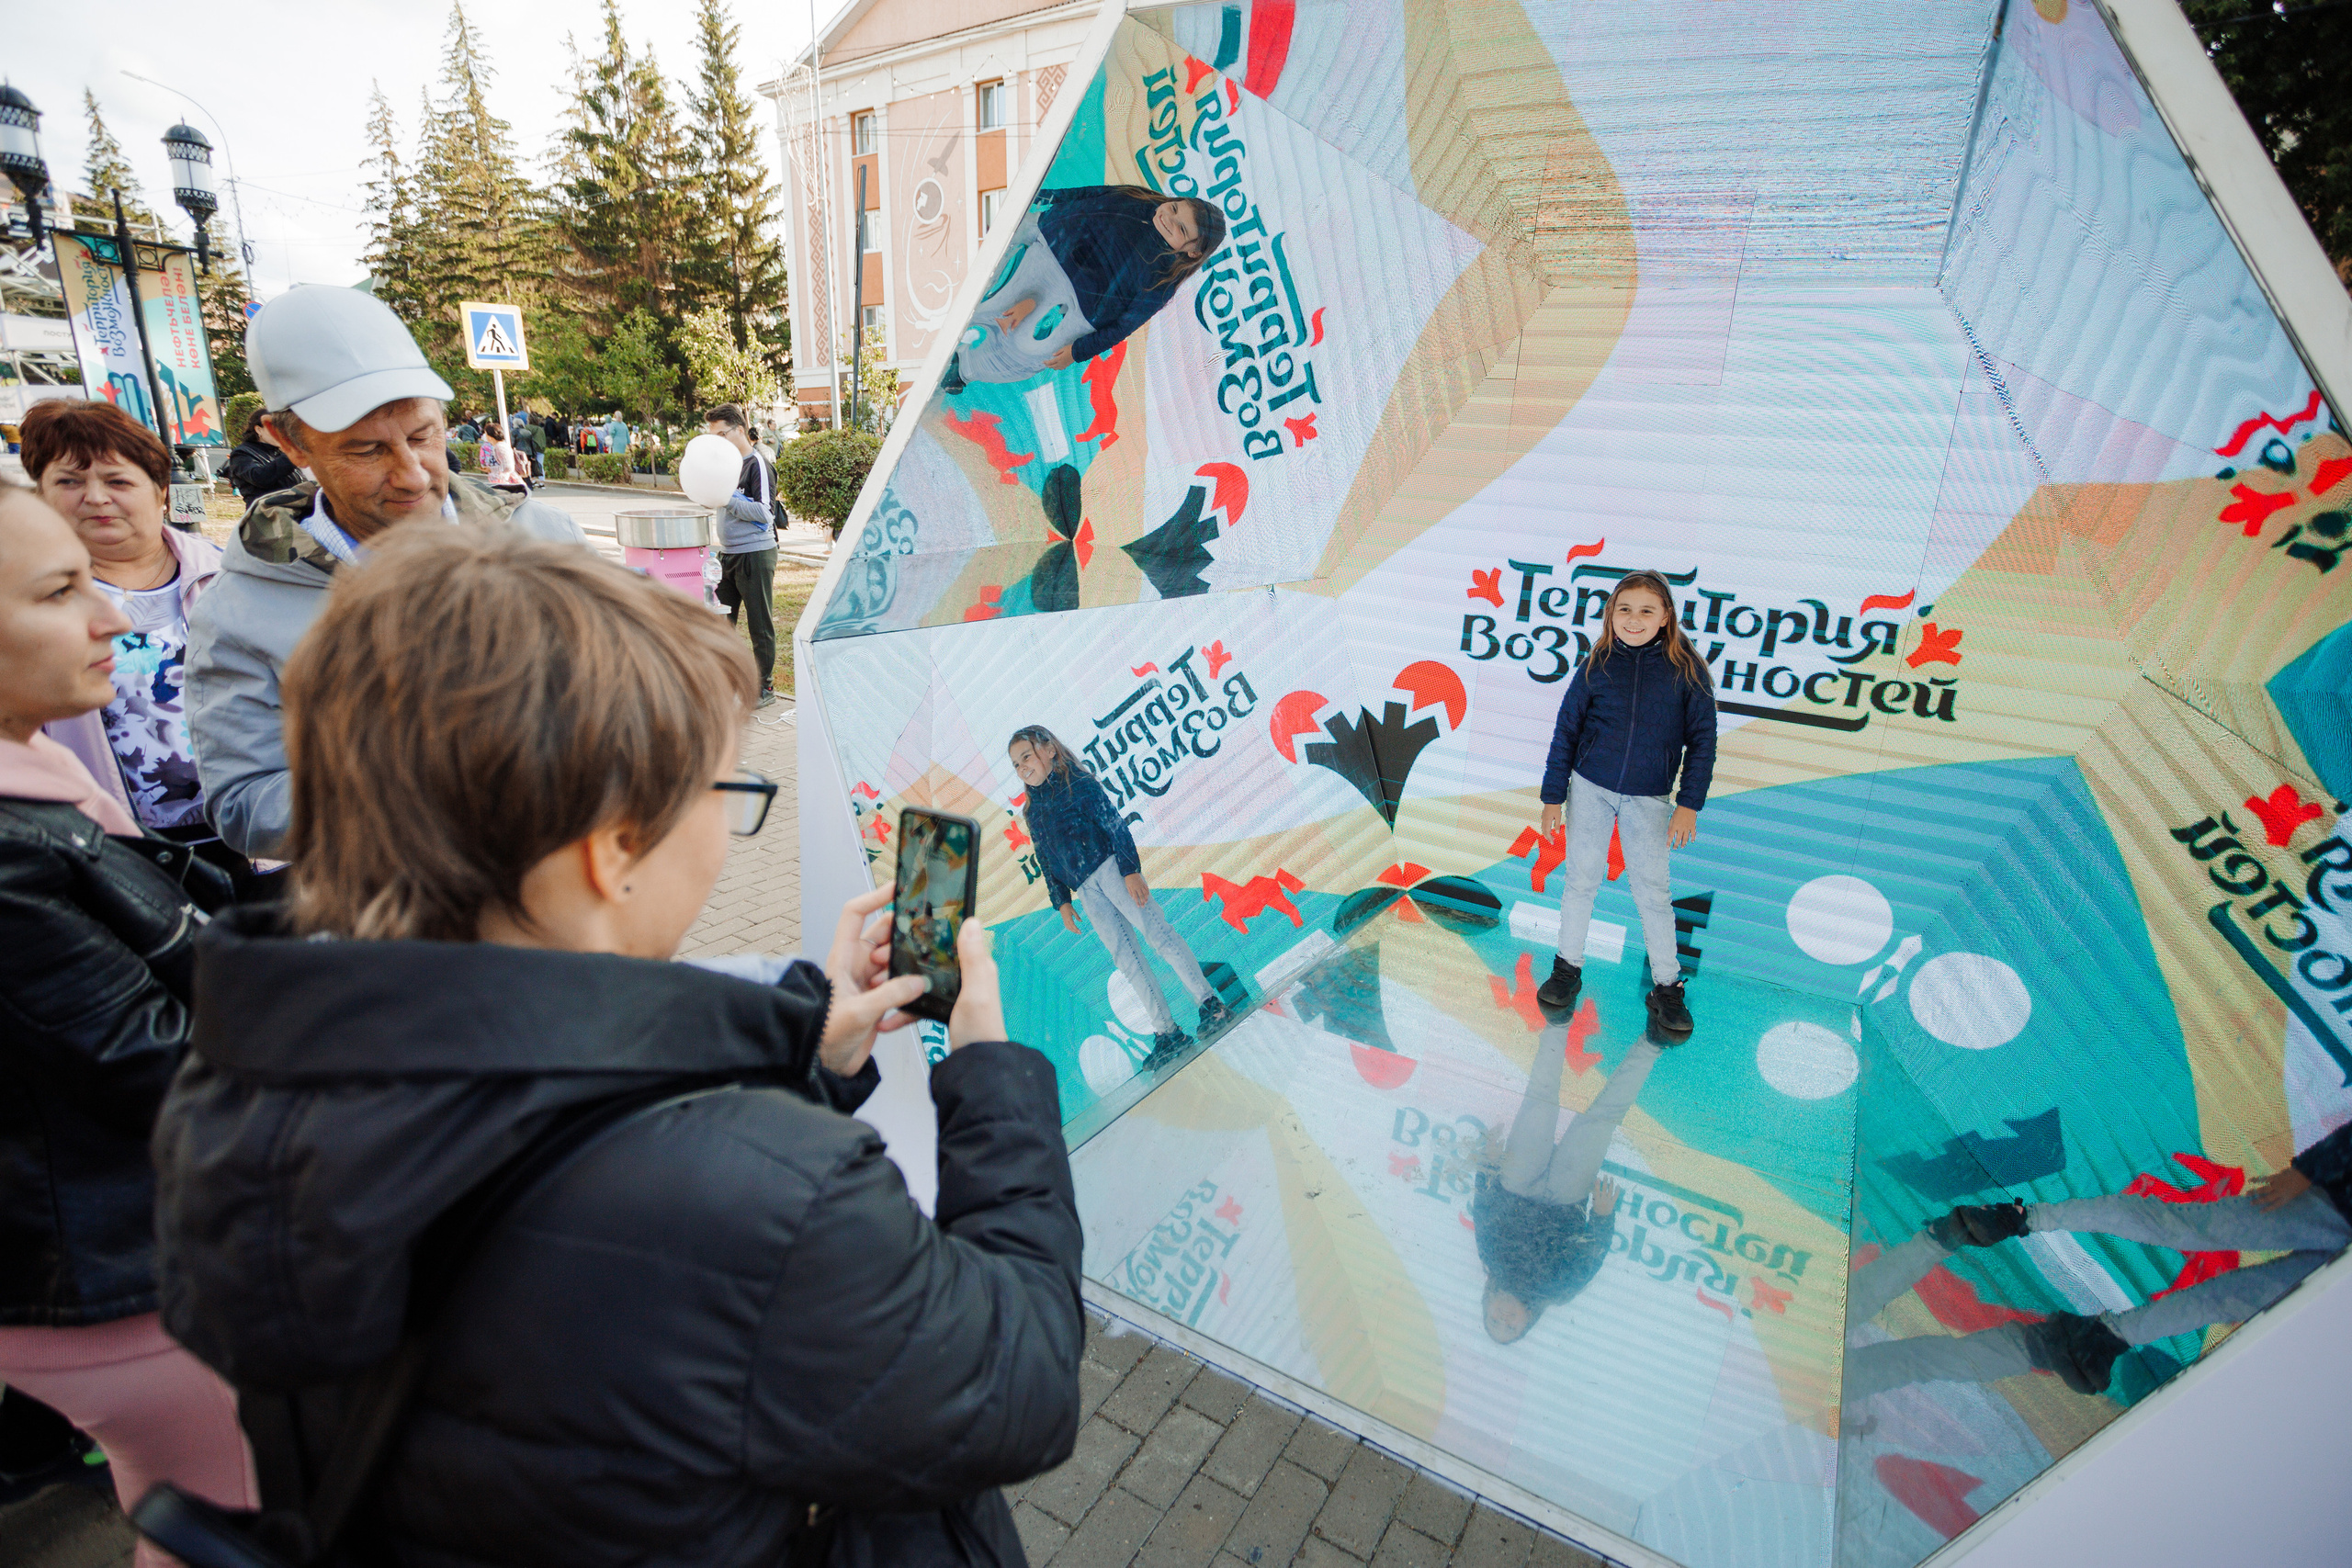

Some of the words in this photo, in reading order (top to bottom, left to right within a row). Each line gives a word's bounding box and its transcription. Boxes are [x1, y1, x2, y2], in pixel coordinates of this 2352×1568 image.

[96, 265, 127, 357] Возможност
[1509, 558, 1902, 664] Тертория
[1460, 614, 1959, 723] Возностей
